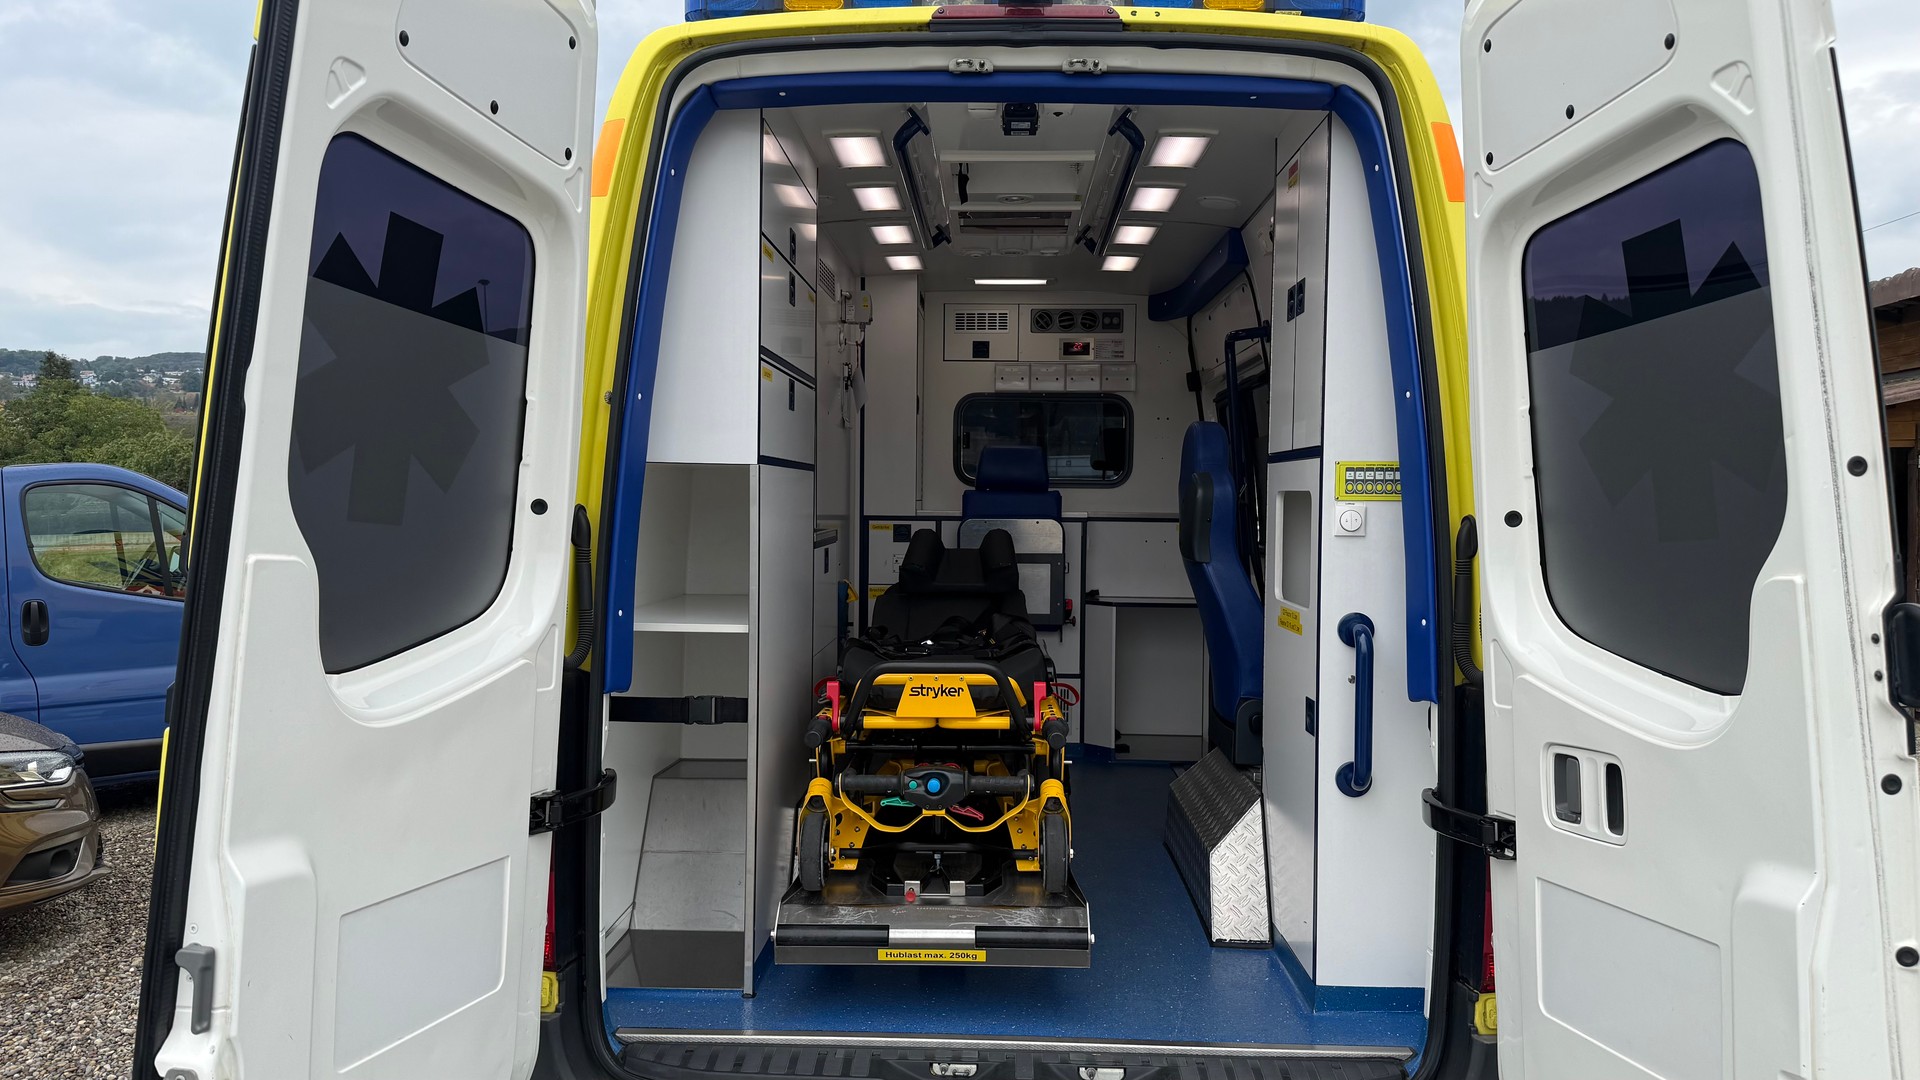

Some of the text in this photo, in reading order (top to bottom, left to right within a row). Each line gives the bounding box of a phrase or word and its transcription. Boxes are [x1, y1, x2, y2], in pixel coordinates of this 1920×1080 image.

[909, 684, 964, 699] stryker
[885, 951, 921, 959] Hublast
[949, 952, 978, 960] 250kg
